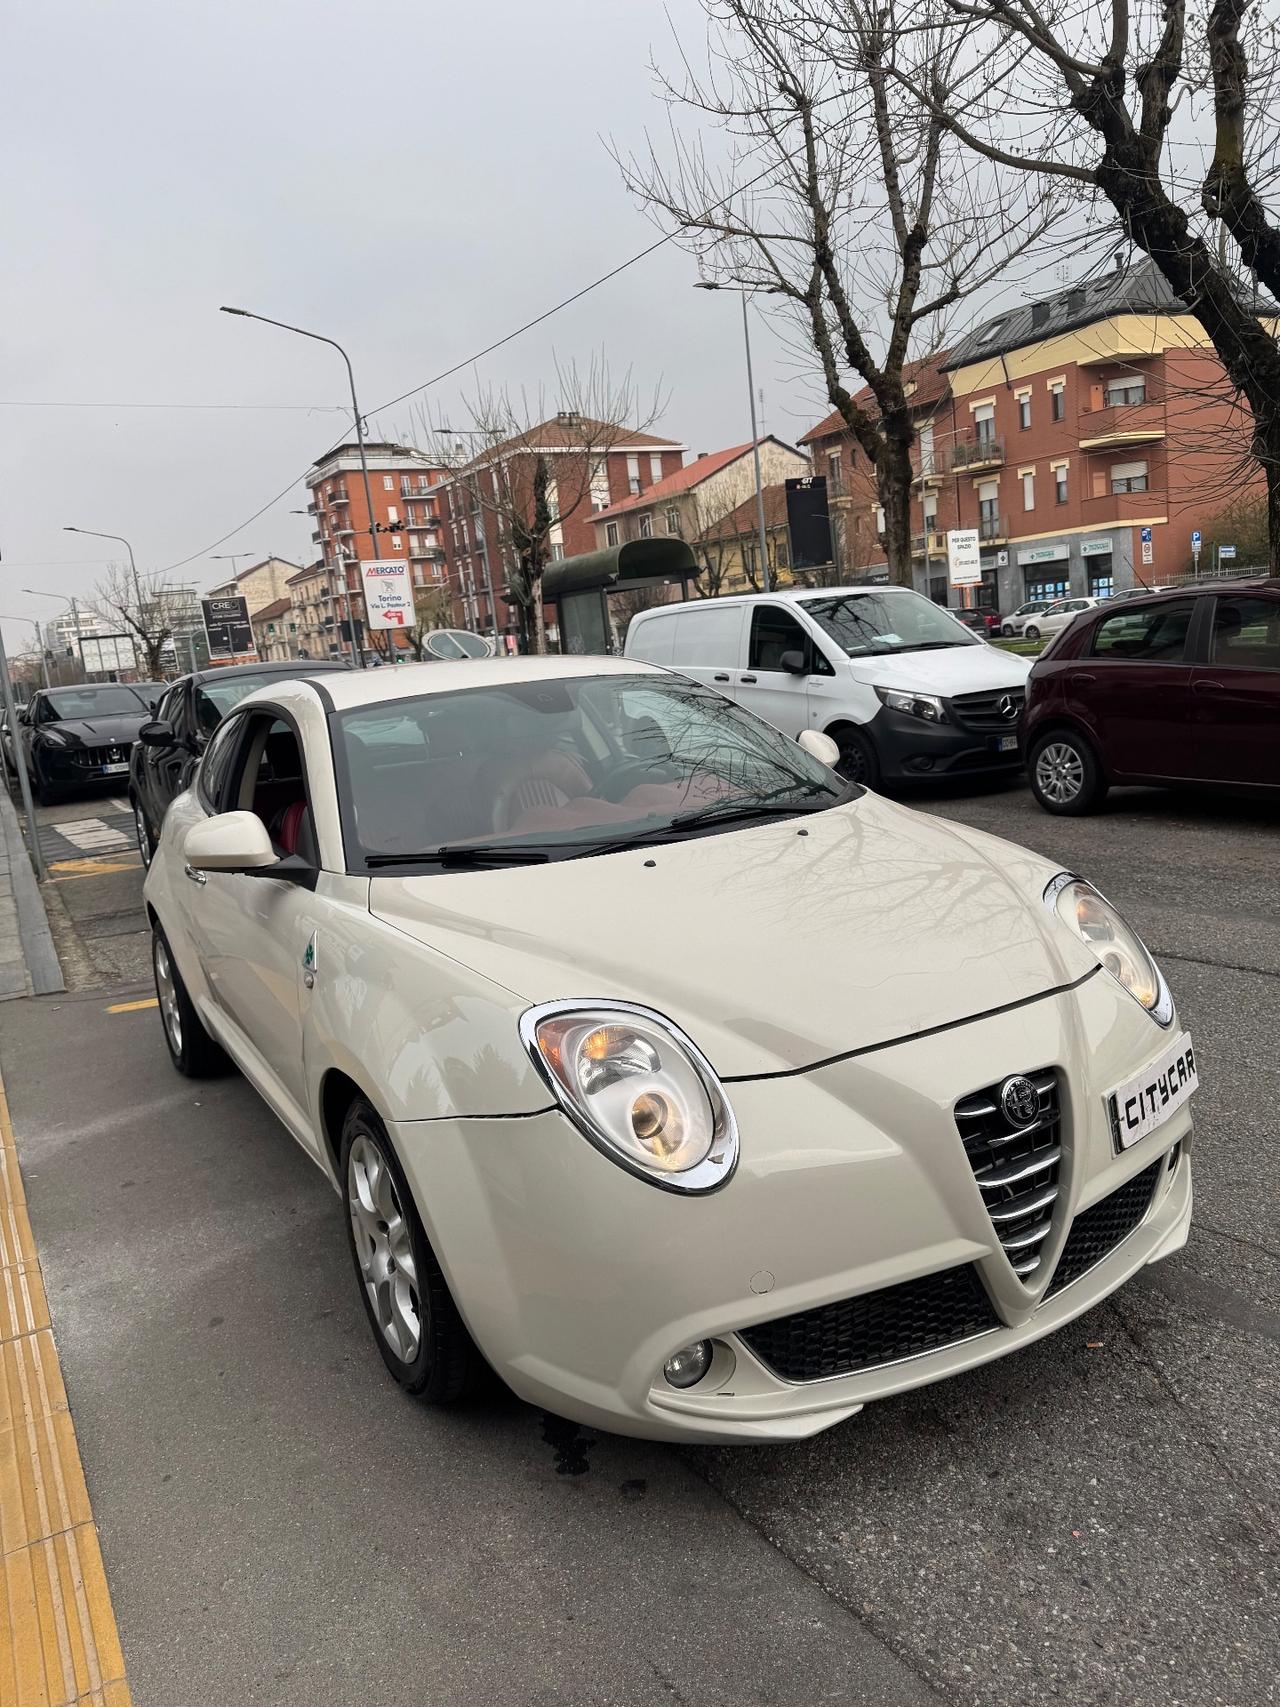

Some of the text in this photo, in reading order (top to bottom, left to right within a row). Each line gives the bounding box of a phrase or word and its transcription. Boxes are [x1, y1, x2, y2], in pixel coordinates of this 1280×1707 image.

[366, 566, 404, 576] MERCATO
[378, 594, 402, 602] Torino
[1125, 1048, 1196, 1129] CITYCAR
